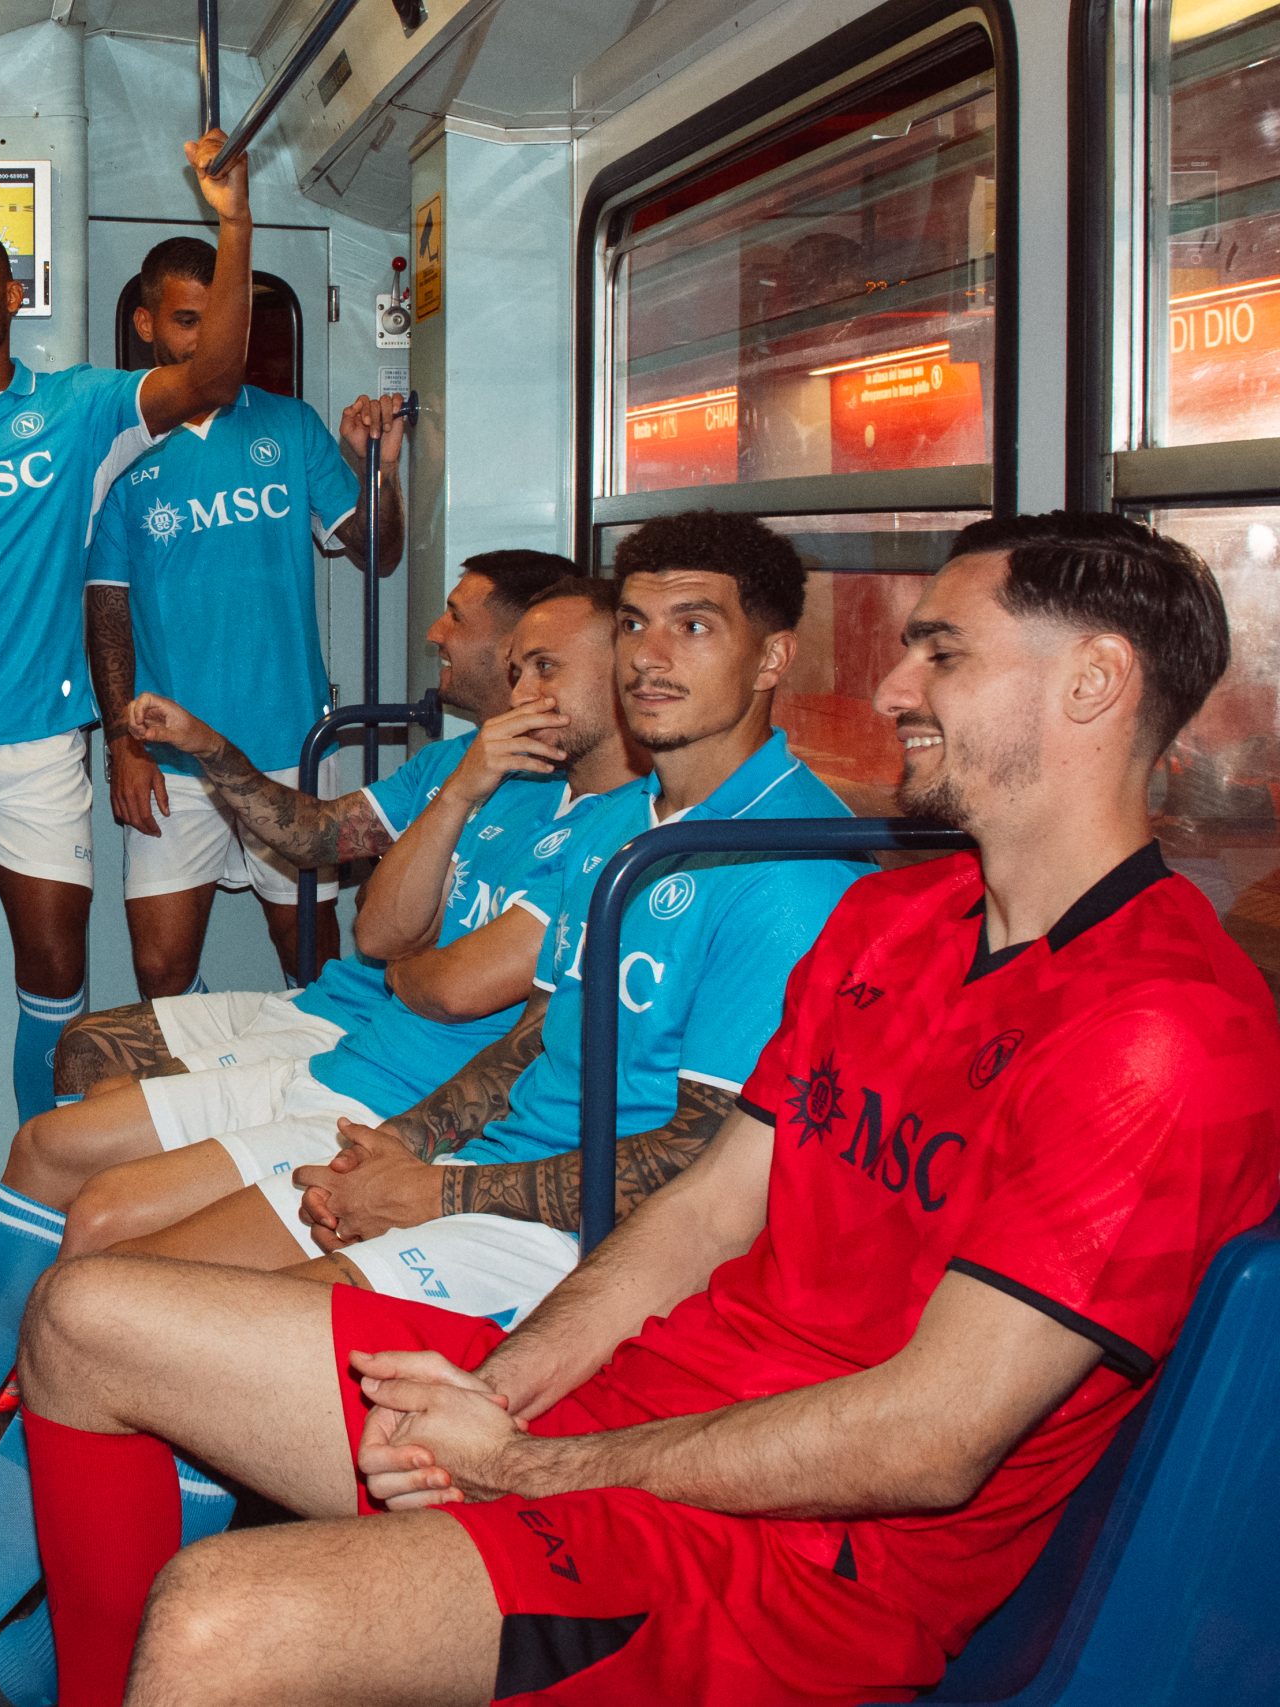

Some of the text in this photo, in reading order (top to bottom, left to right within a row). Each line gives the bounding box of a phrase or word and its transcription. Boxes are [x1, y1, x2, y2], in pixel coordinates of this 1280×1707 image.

[1170, 303, 1254, 353] DI DIO
[130, 466, 160, 486] EA7
[187, 483, 291, 533] MSC
[839, 1086, 967, 1213] MSC
[399, 1247, 451, 1299] EA7
[517, 1510, 582, 1585] EA7
